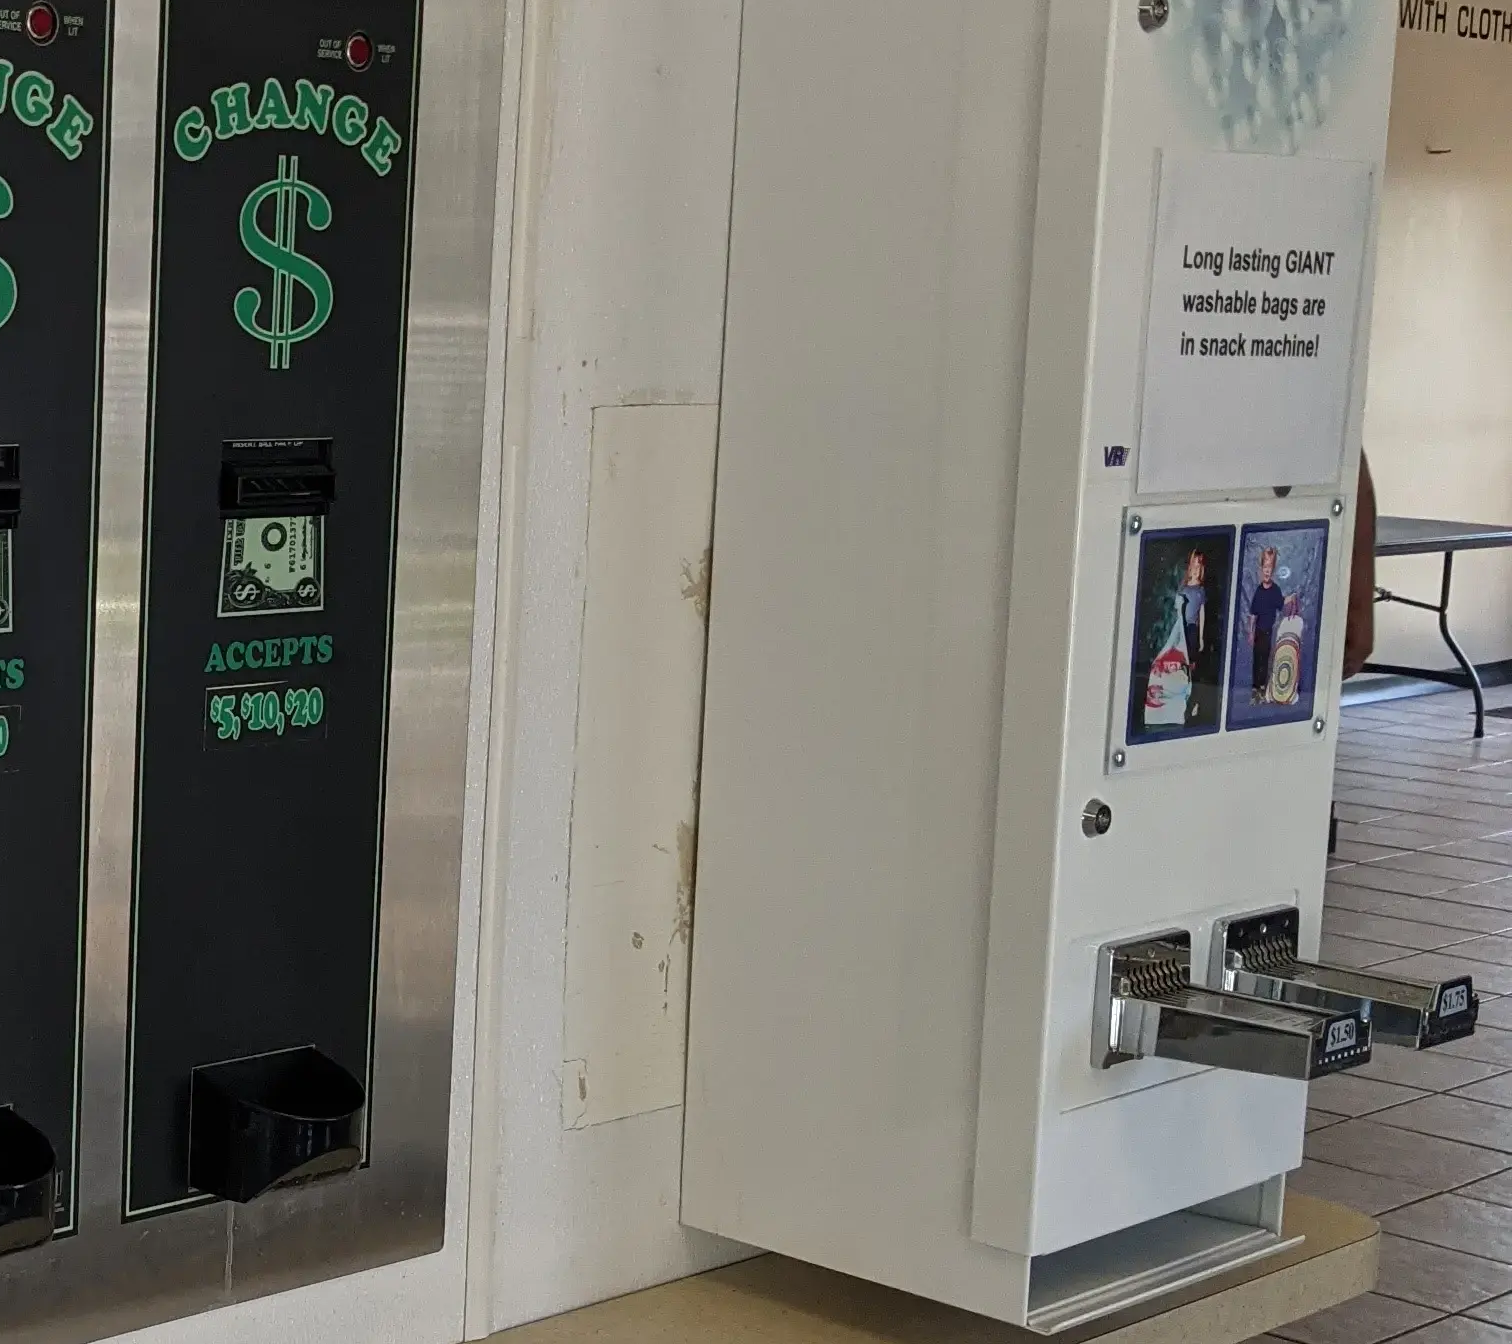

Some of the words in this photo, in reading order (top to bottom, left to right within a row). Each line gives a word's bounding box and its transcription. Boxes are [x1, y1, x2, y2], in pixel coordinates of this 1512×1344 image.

[10, 10, 20, 20] OF
[319, 38, 333, 49] OUT
[174, 77, 402, 177] CHANGE
[233, 154, 334, 369] $
[1183, 244, 1224, 276] Long
[1228, 246, 1281, 279] lasting
[1285, 249, 1335, 276] GIANT
[1182, 289, 1257, 314] washable
[1261, 291, 1298, 321] bags
[1302, 298, 1326, 316] are
[1180, 331, 1195, 356] in
[1199, 332, 1246, 357] snack
[1251, 333, 1320, 357] machine!
[204, 634, 334, 673] ACCEPTS
[1441, 990, 1465, 1014] $1.75
[1330, 1022, 1355, 1047] $1.50
